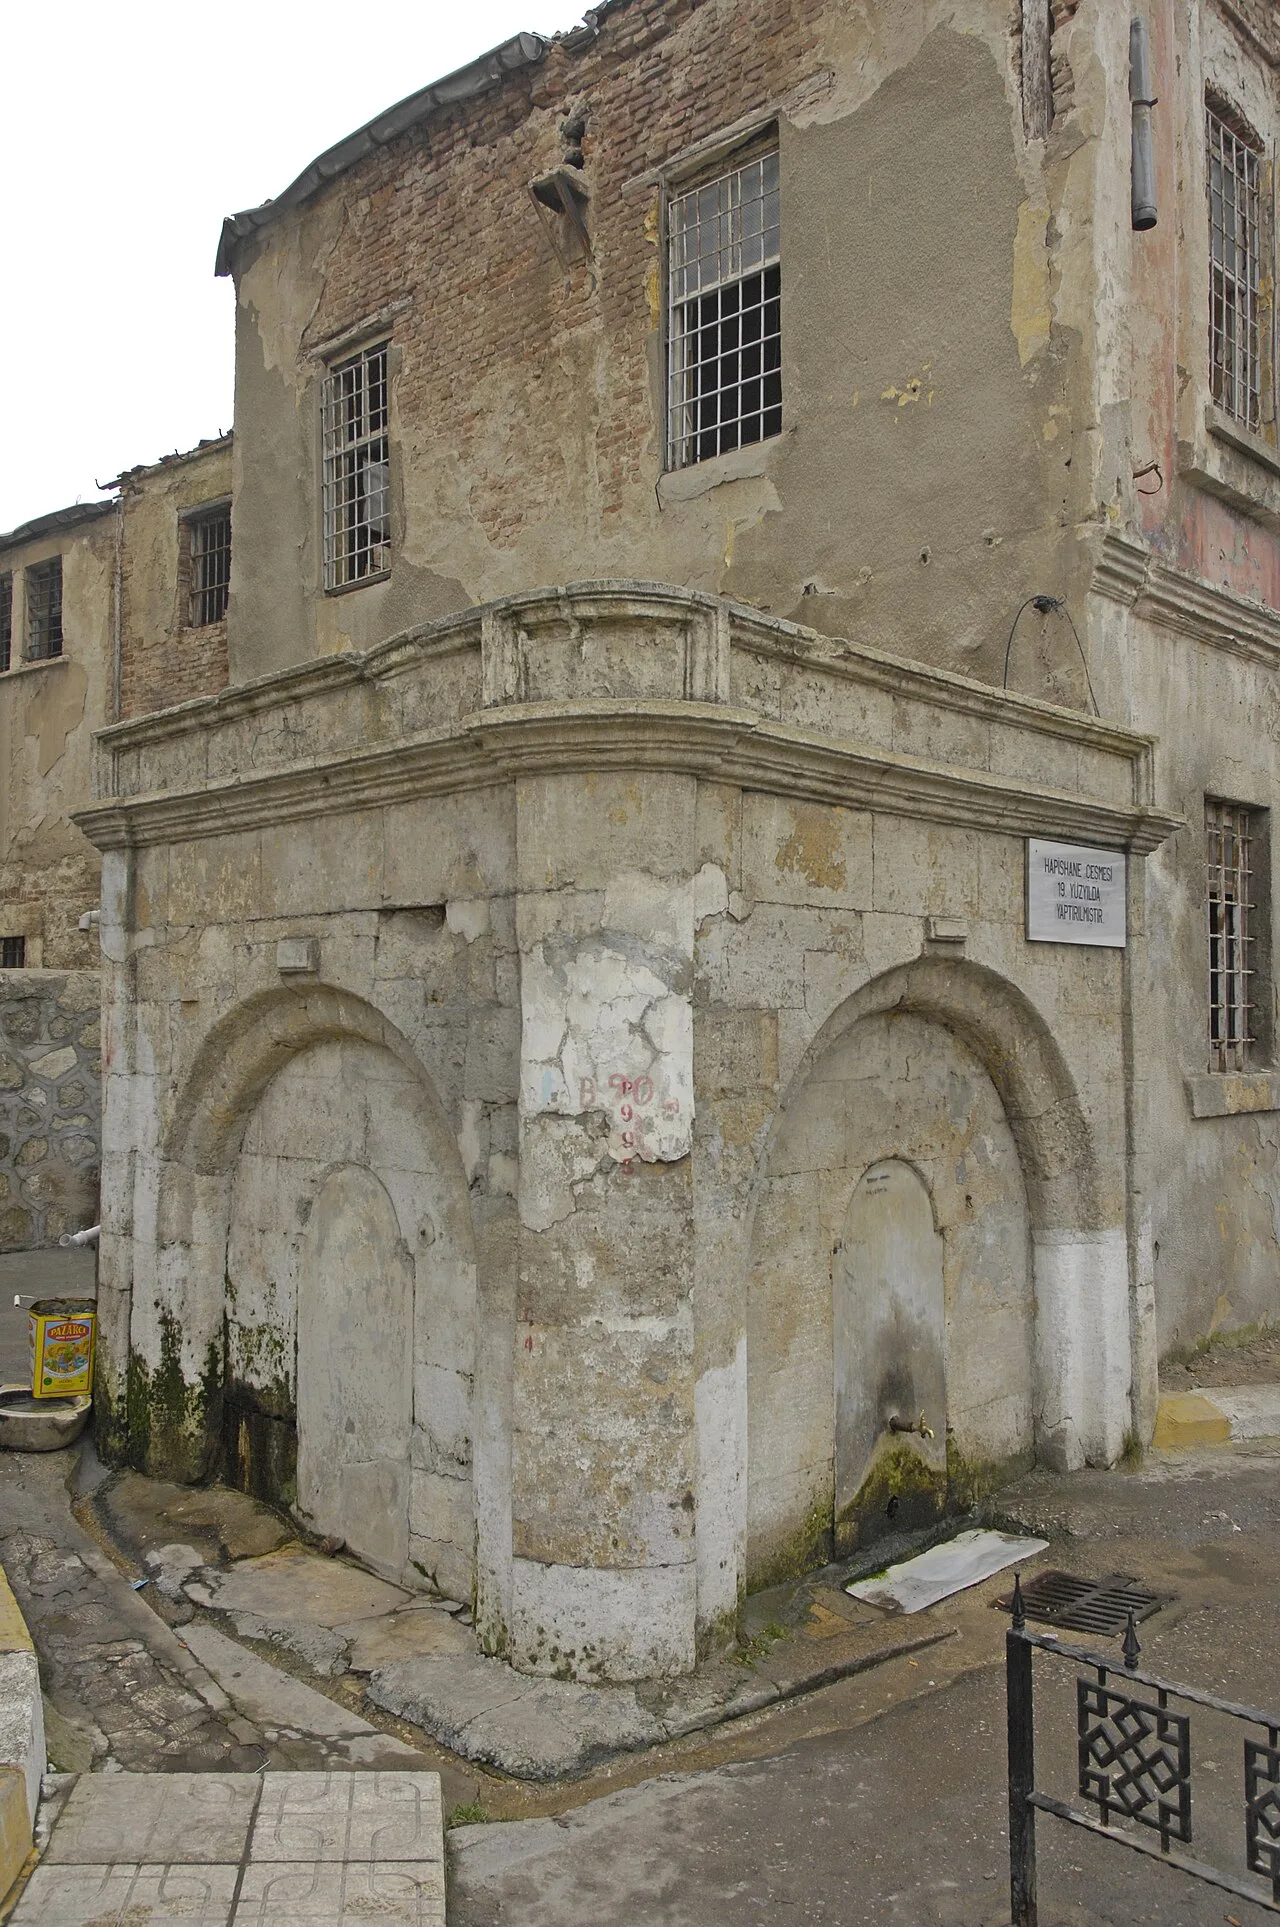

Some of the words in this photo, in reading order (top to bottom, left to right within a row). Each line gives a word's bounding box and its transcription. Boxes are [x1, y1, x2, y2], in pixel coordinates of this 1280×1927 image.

[1044, 857, 1082, 878] HAPİSHANE
[1085, 864, 1113, 883] ÇEŞMESİ
[1057, 882, 1067, 898] 19.
[1070, 882, 1101, 902] YÜZYILDA
